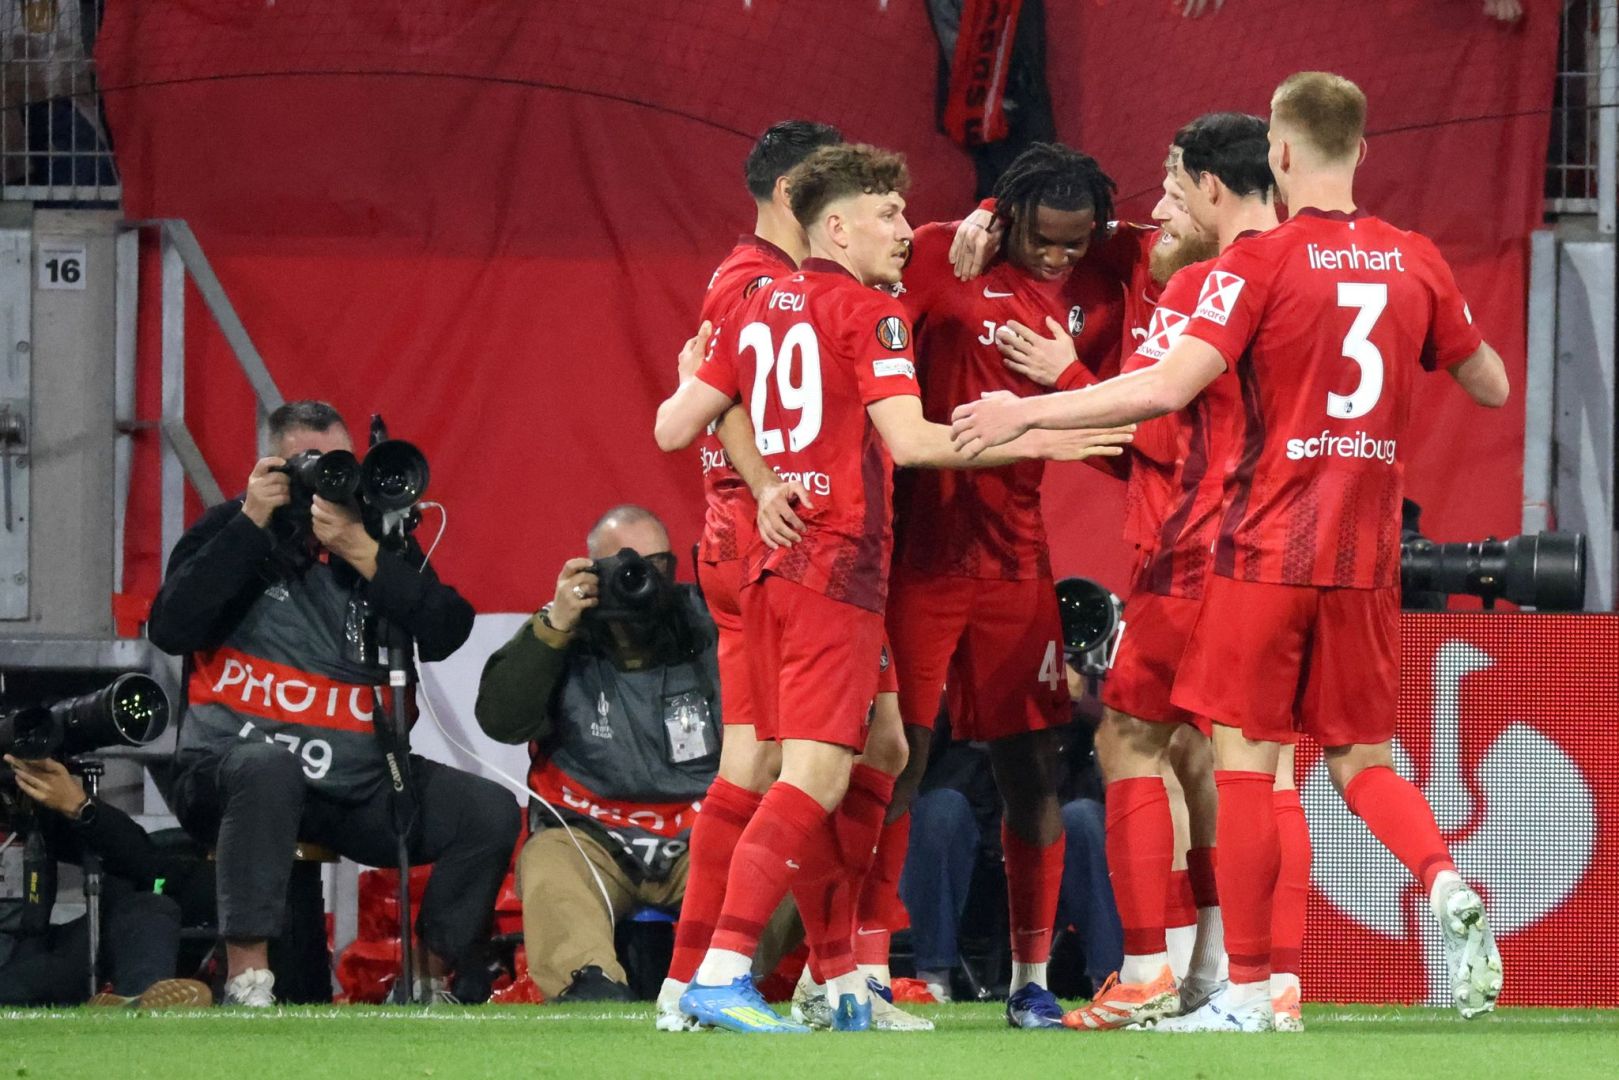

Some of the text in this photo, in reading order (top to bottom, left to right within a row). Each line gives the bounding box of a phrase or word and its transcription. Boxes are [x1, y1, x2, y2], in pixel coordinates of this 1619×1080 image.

[45, 258, 81, 283] 16
[1307, 244, 1405, 272] lienhart
[738, 321, 822, 456] 29
[1326, 282, 1388, 419] 3
